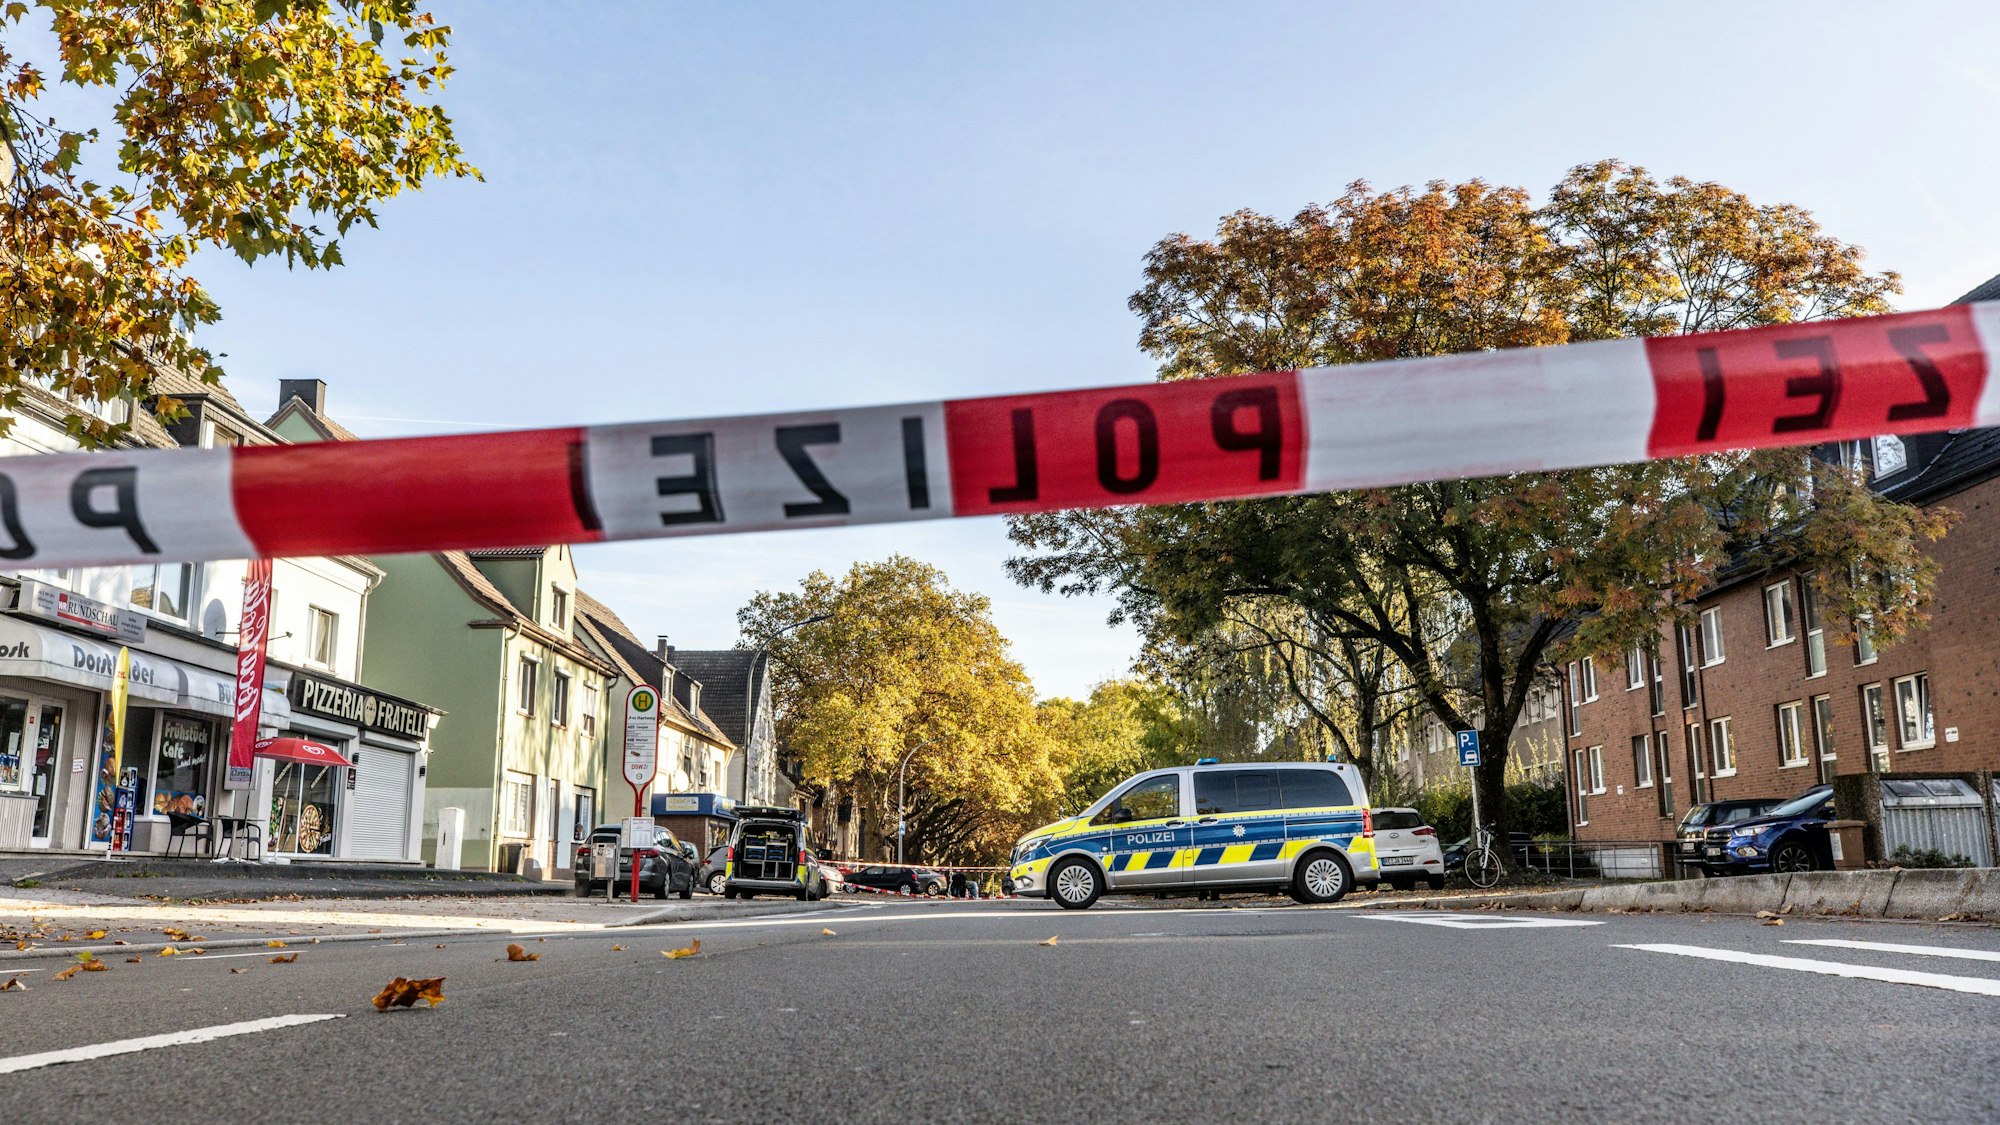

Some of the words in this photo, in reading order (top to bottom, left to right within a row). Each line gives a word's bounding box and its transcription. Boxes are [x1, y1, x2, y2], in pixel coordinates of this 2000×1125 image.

[67, 601, 119, 626] RUNDSCHAU
[302, 678, 364, 722] PIZZERIA
[377, 700, 428, 738] FRATELLI
[165, 721, 208, 745] Frühstück
[1460, 733, 1470, 748] P
[162, 741, 184, 759] Café
[1127, 831, 1175, 845] POLIZEI
